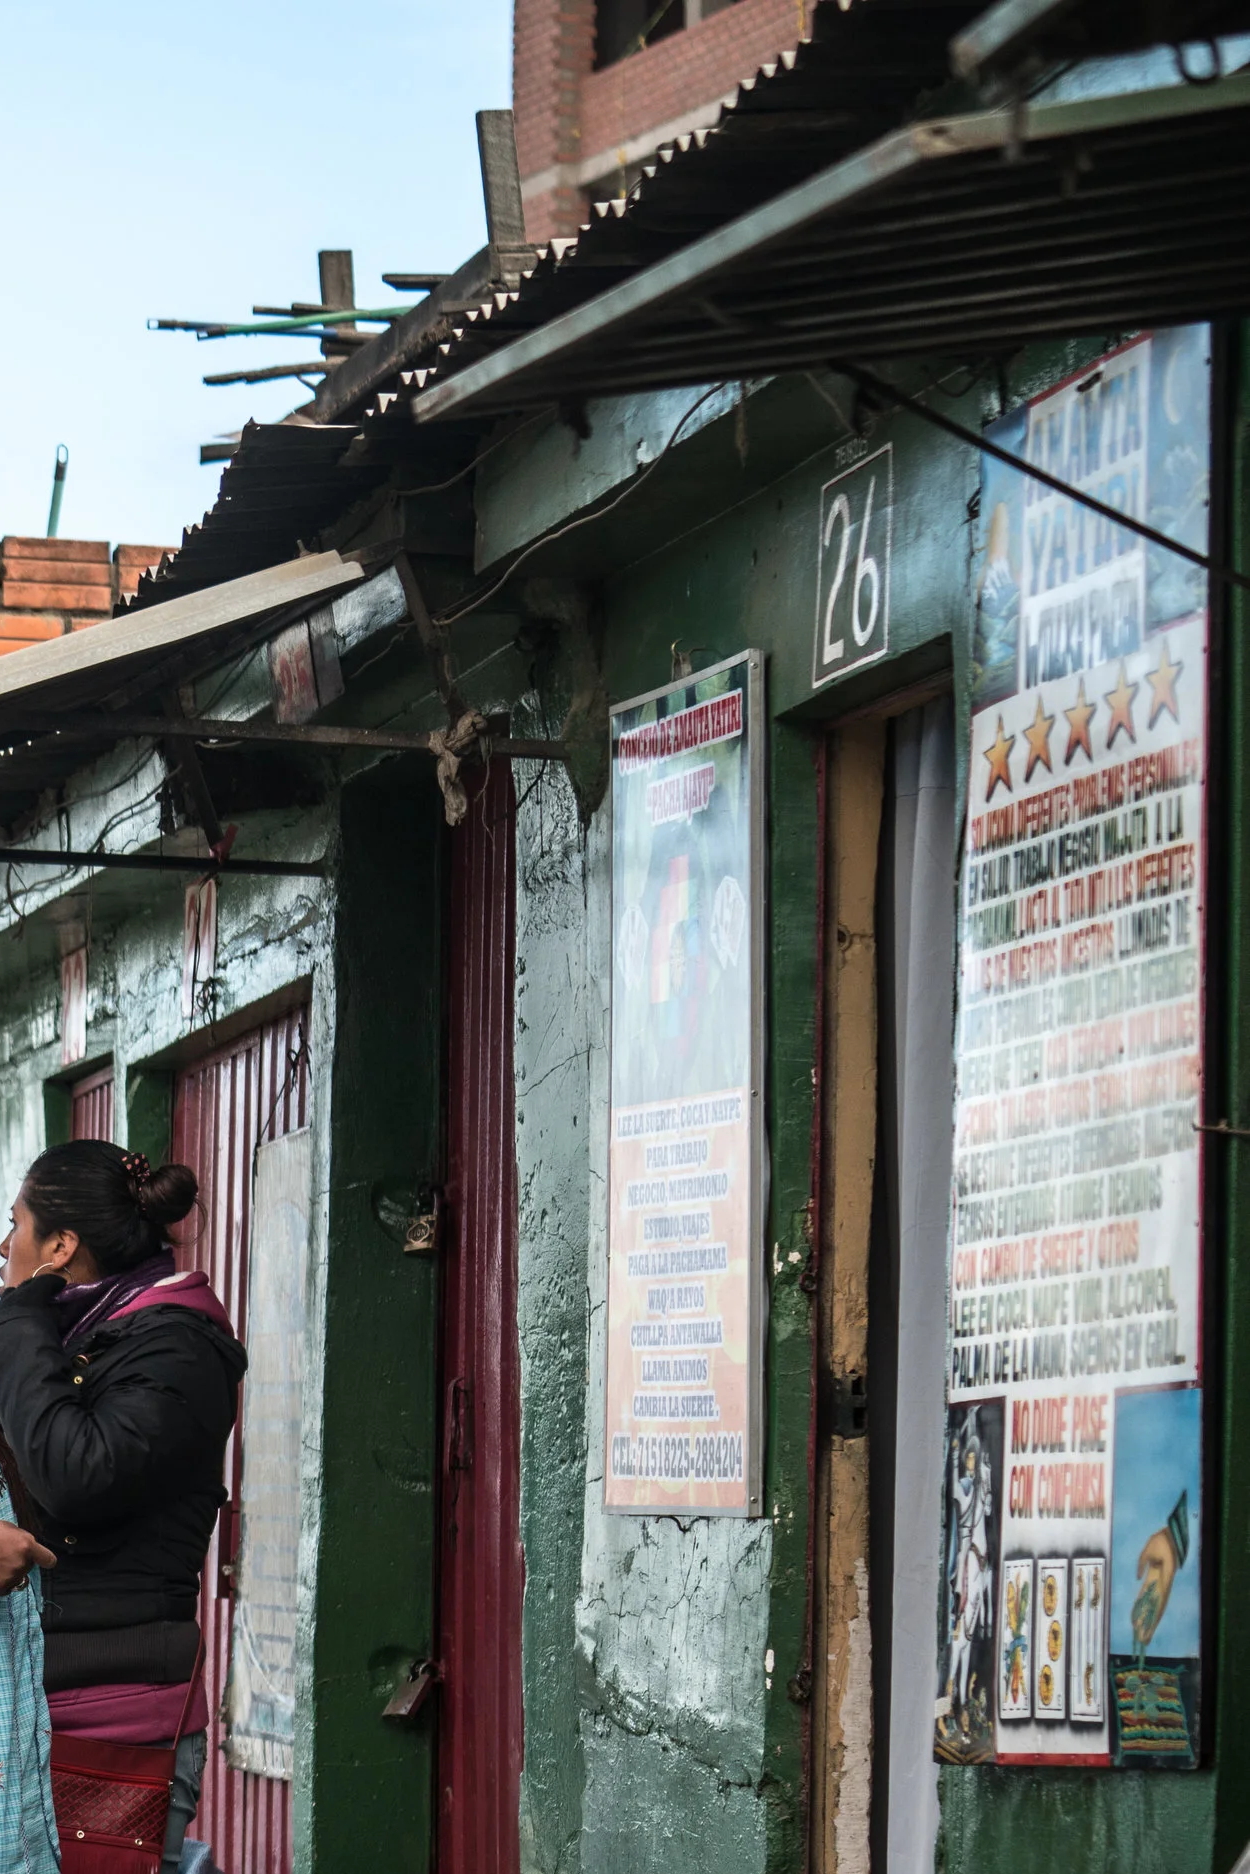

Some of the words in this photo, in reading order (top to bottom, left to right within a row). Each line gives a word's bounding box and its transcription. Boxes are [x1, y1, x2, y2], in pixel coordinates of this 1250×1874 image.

[823, 475, 879, 664] 26
[619, 725, 657, 772] CONCEJO
[659, 718, 672, 760] DE
[672, 704, 710, 753] AMAUTA
[710, 692, 741, 739] YATIRI
[981, 852, 1014, 901] SALUD
[1014, 837, 1057, 892] TRABAJO
[1058, 825, 1101, 880] NEGOSIO
[617, 1114, 632, 1138] LEE
[633, 1113, 644, 1135] LA
[680, 1103, 704, 1127] COCA
[647, 1144, 669, 1169] PARA
[670, 1139, 708, 1167] TRABAJO
[627, 1180, 667, 1208] NEGOCIO,
[669, 1173, 727, 1203] MATRIMONIO
[628, 1253, 650, 1277] PAGA
[657, 1252, 669, 1274] LA
[669, 1244, 727, 1274] PACHAMAMA
[956, 1252, 976, 1291] CON
[981, 1239, 1022, 1285] CAMBIO
[1024, 1235, 1039, 1279] DE
[1040, 1227, 1084, 1276] SUERTE
[1098, 1219, 1140, 1269] OTROS
[677, 1284, 704, 1310] RAYOS
[954, 1294, 977, 1338] LEE
[979, 1290, 995, 1336] EN
[997, 1284, 1030, 1333] COCA
[631, 1324, 668, 1347] CHULLPA
[669, 1320, 722, 1345] ANTAWALLA
[642, 1360, 672, 1382] LLAMA
[672, 1357, 708, 1381] ANIMOS
[953, 1341, 990, 1389] PALMA
[993, 1339, 1010, 1385] DE
[1012, 1336, 1029, 1383] LA
[1124, 1321, 1143, 1371] EN
[634, 1394, 667, 1417] CAMBIA
[667, 1394, 679, 1416] LA
[1013, 1400, 1031, 1453] NO
[1033, 1396, 1068, 1453] DUDE
[1073, 1394, 1107, 1452] PASE
[612, 1437, 637, 1477] CEL:
[1010, 1466, 1034, 1519] CON
